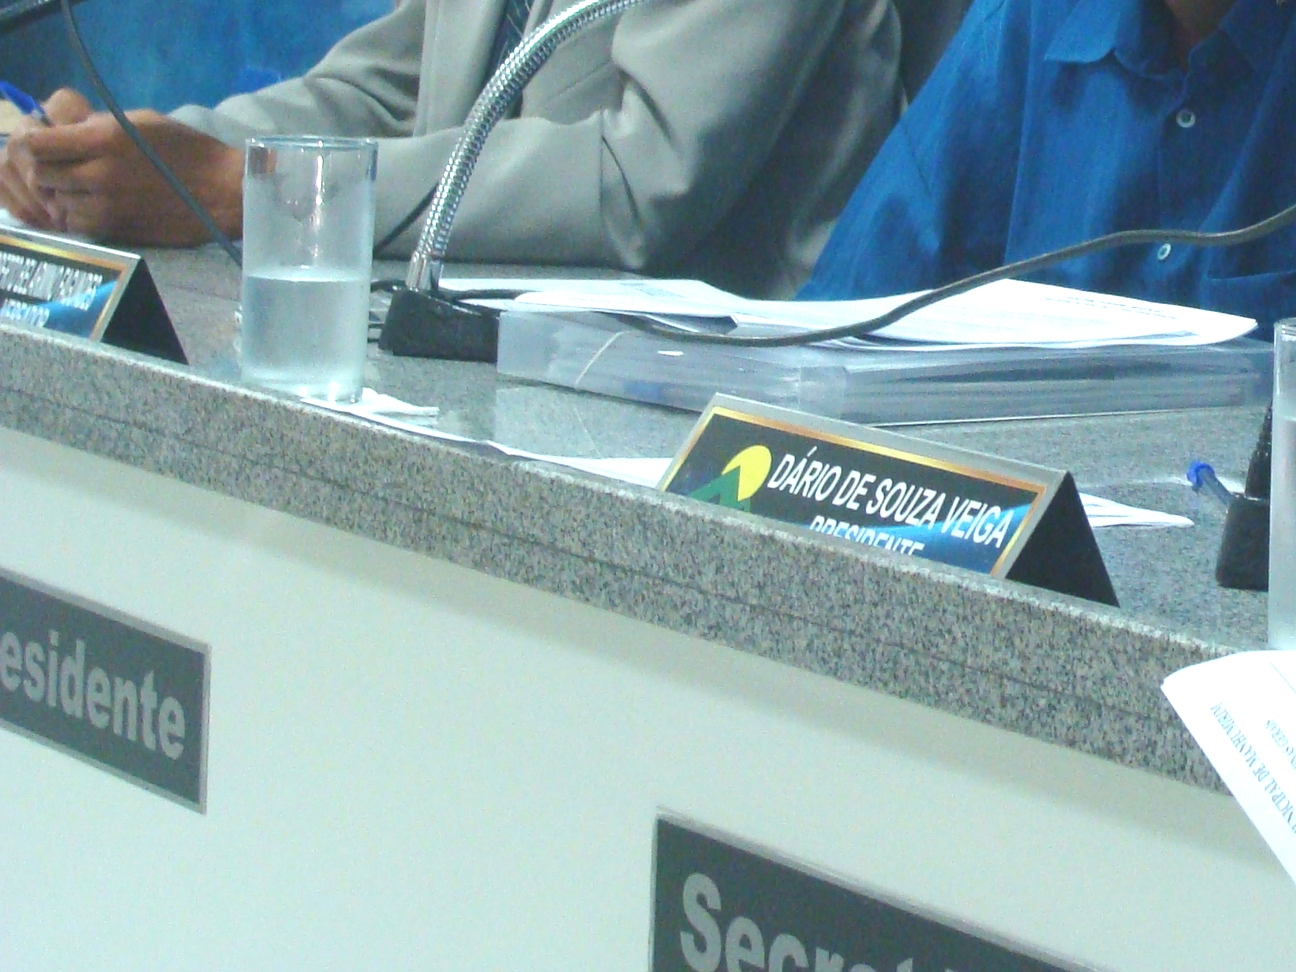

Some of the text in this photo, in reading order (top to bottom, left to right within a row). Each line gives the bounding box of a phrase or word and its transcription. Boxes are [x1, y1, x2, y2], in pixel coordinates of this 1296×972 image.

[767, 445, 1015, 549] DÁRIO DE SOUZA VEIGA
